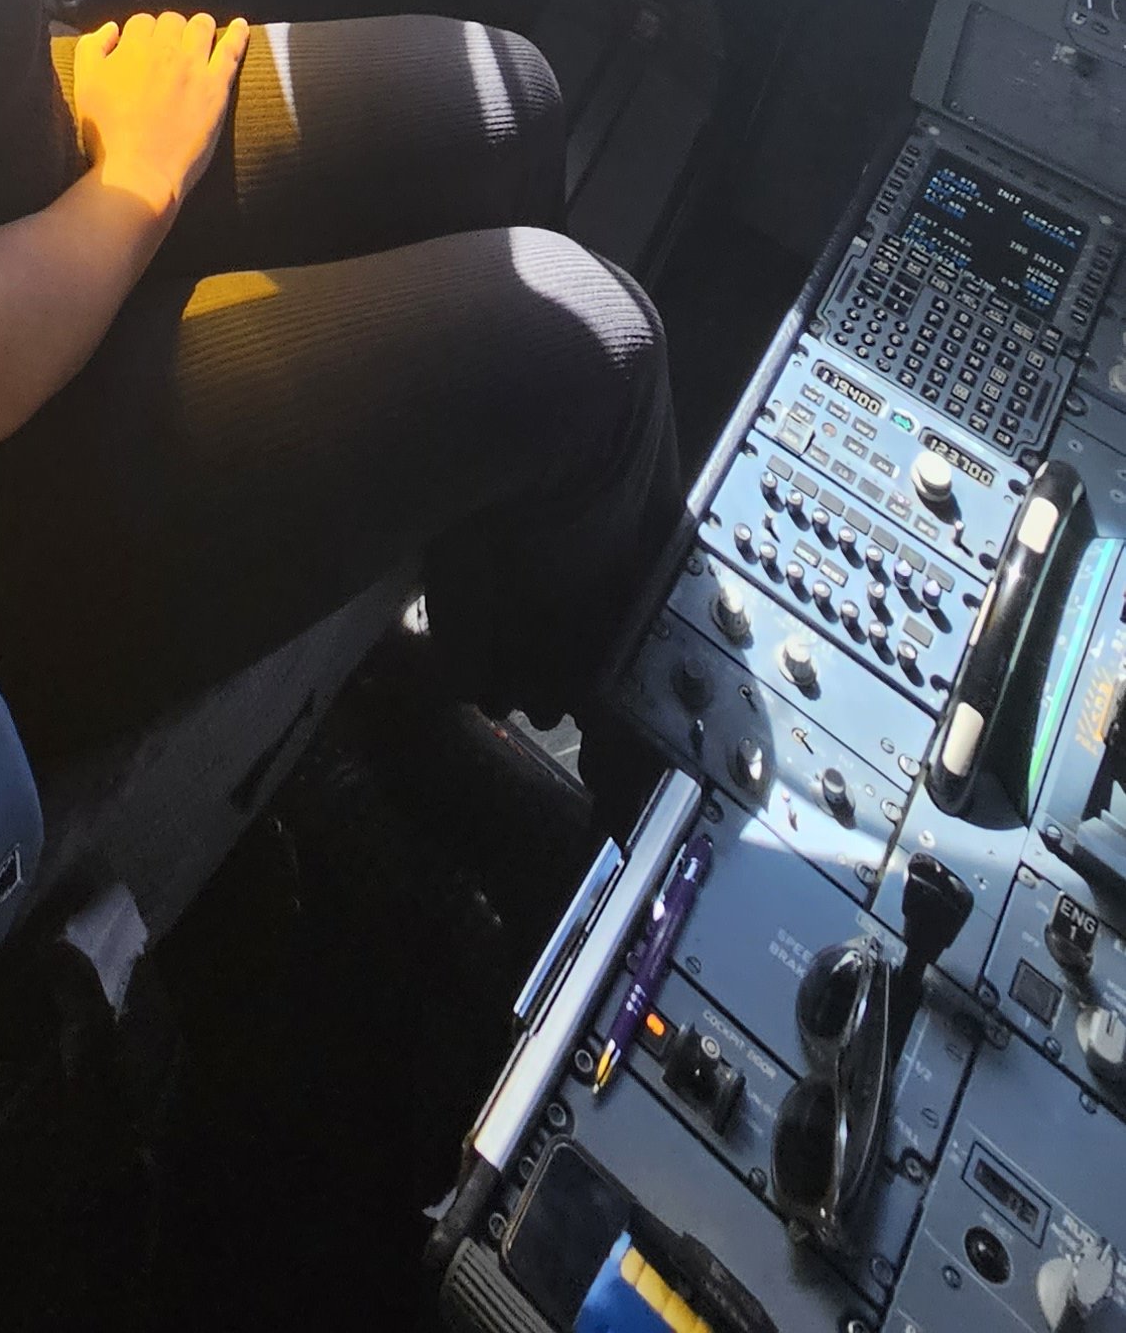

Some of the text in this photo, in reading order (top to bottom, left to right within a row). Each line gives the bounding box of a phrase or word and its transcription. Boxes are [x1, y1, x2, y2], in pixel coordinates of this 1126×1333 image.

[997, 188, 1022, 205] INIT
[936, 300, 945, 309] A
[982, 327, 992, 336] C
[1059, 900, 1097, 934] ENG
[1069, 925, 1077, 940] 1
[777, 928, 816, 965] SPEE
[769, 939, 807, 980] BRAK
[702, 1009, 777, 1079] COCKPIT DOOR
